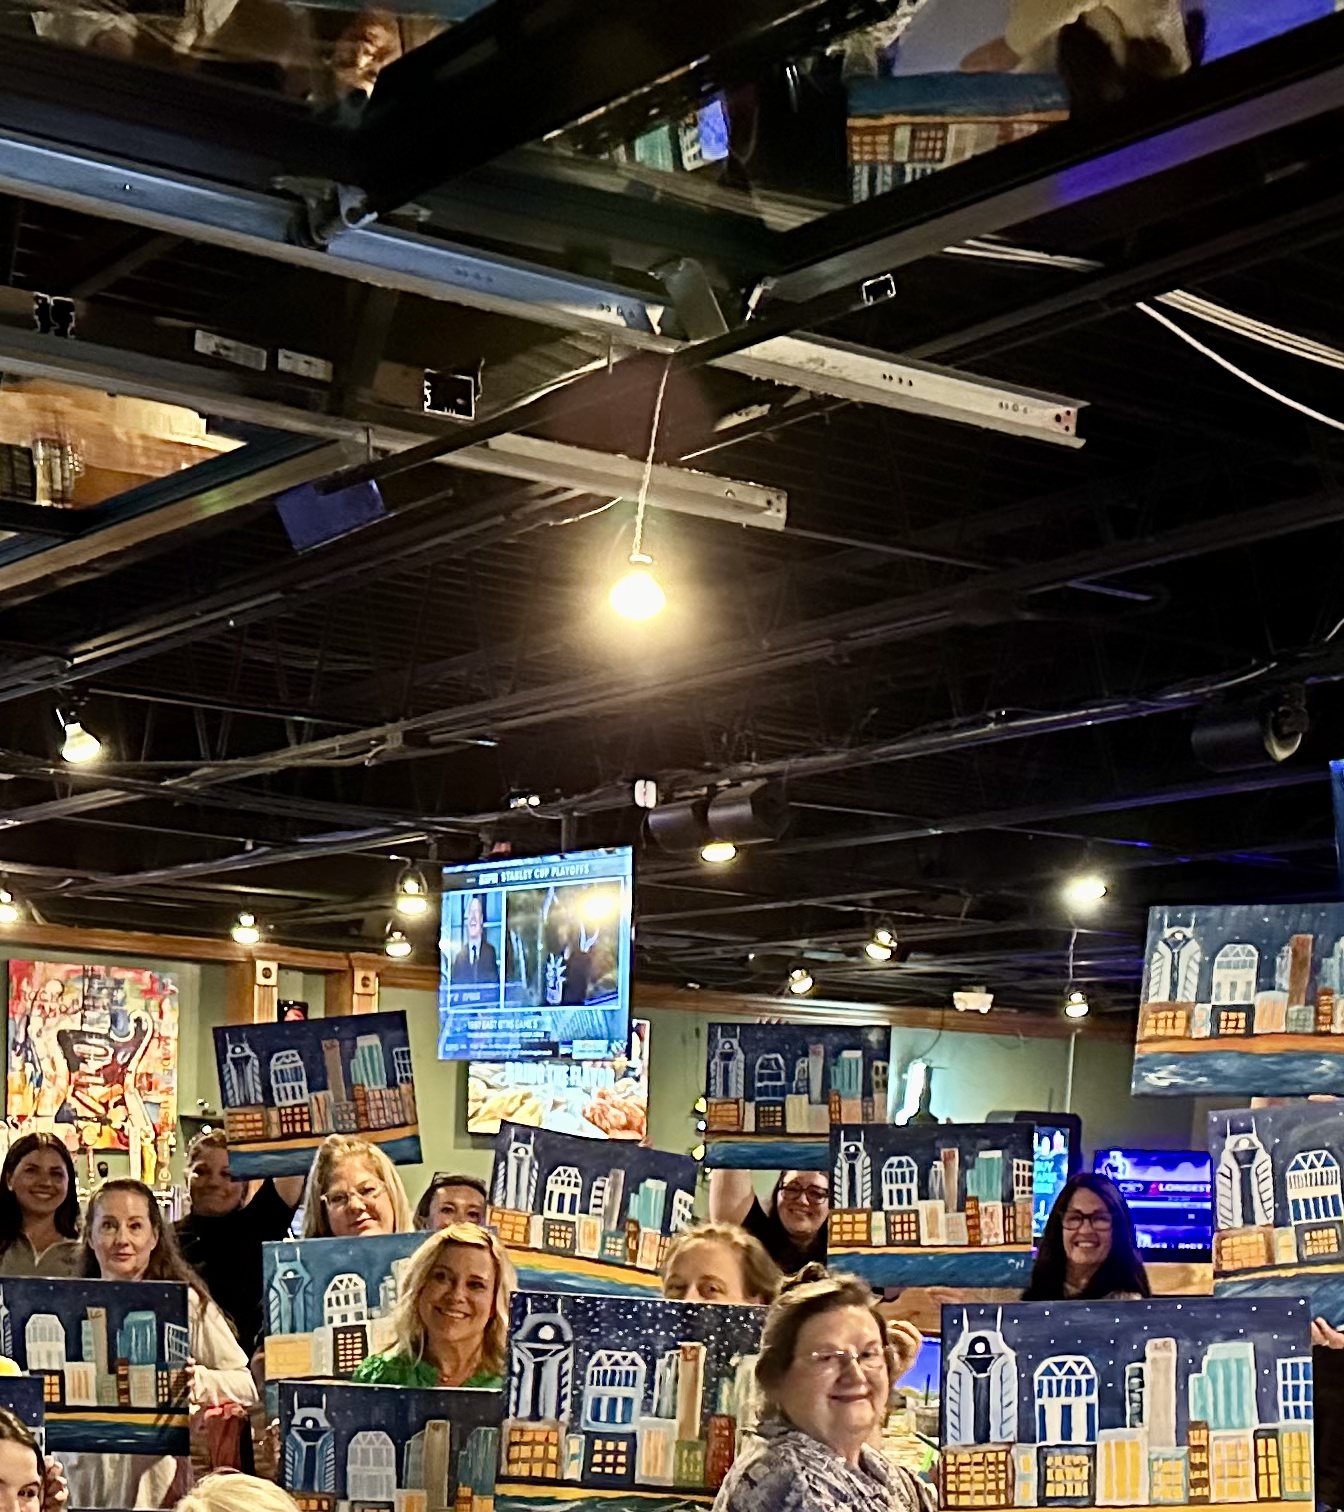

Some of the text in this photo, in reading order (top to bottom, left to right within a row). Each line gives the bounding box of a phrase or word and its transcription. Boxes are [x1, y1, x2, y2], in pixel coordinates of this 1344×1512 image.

[534, 867, 549, 878] CUP
[551, 864, 590, 877] PLAYOFFS
[1158, 1182, 1212, 1193] LONGEST
